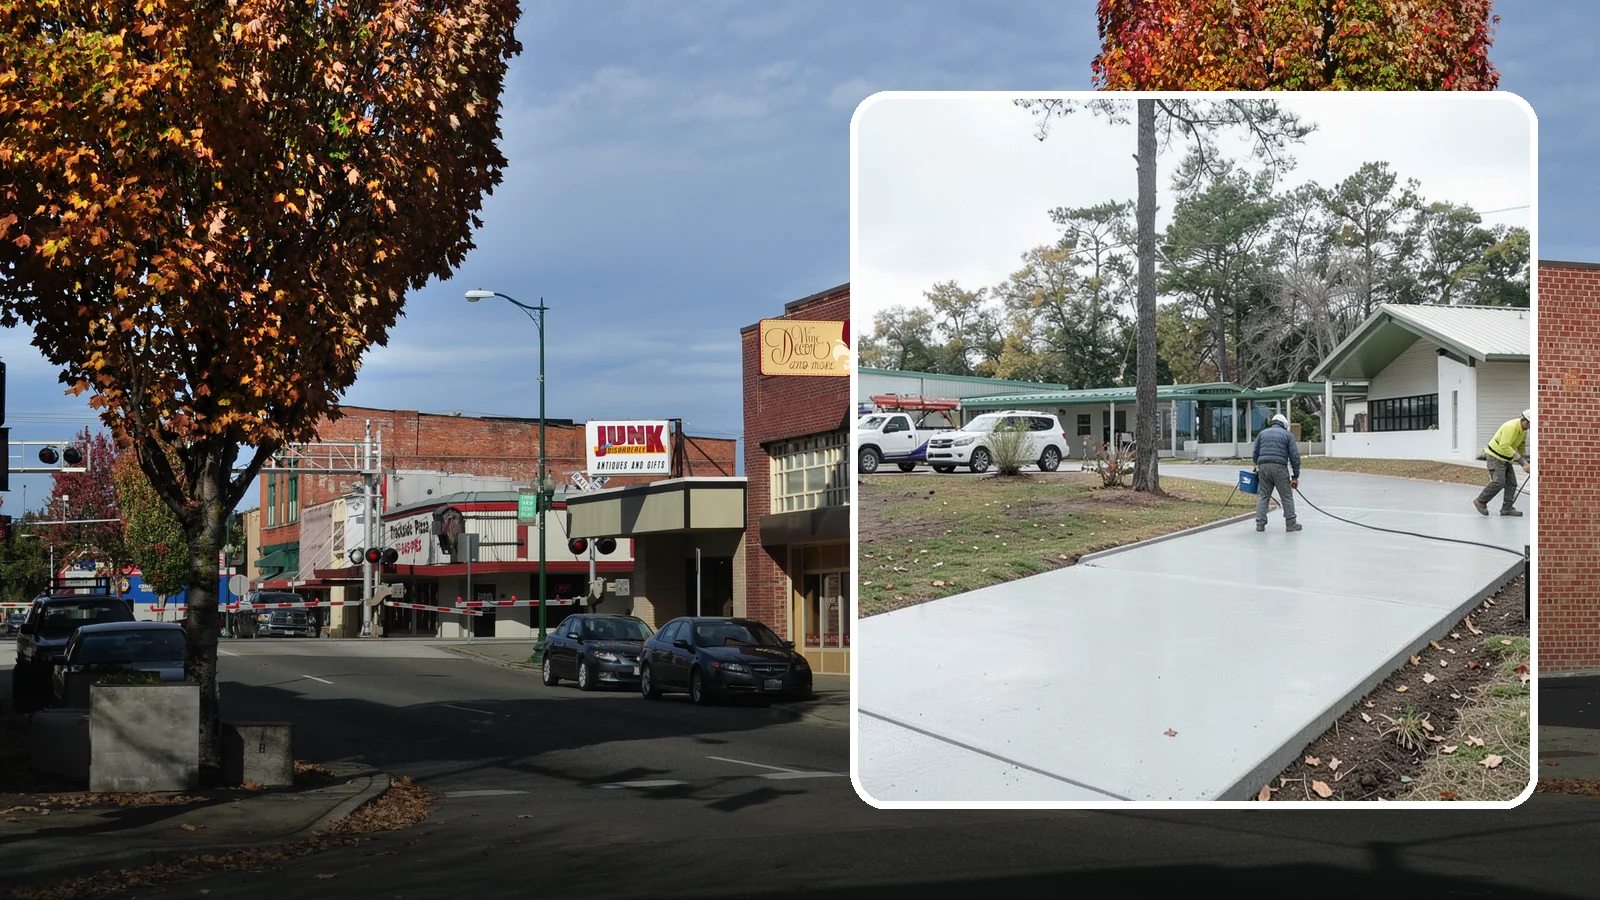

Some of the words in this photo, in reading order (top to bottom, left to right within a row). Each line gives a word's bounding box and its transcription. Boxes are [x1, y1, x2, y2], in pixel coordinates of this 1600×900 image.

[595, 425, 665, 457] JUNK
[607, 446, 646, 454] DISORDERLY
[597, 461, 628, 470] ANTIQUES
[631, 461, 644, 470] AND
[647, 460, 665, 469] GIFTS
[390, 521, 413, 539] Trackside
[414, 519, 429, 535] Pizza
